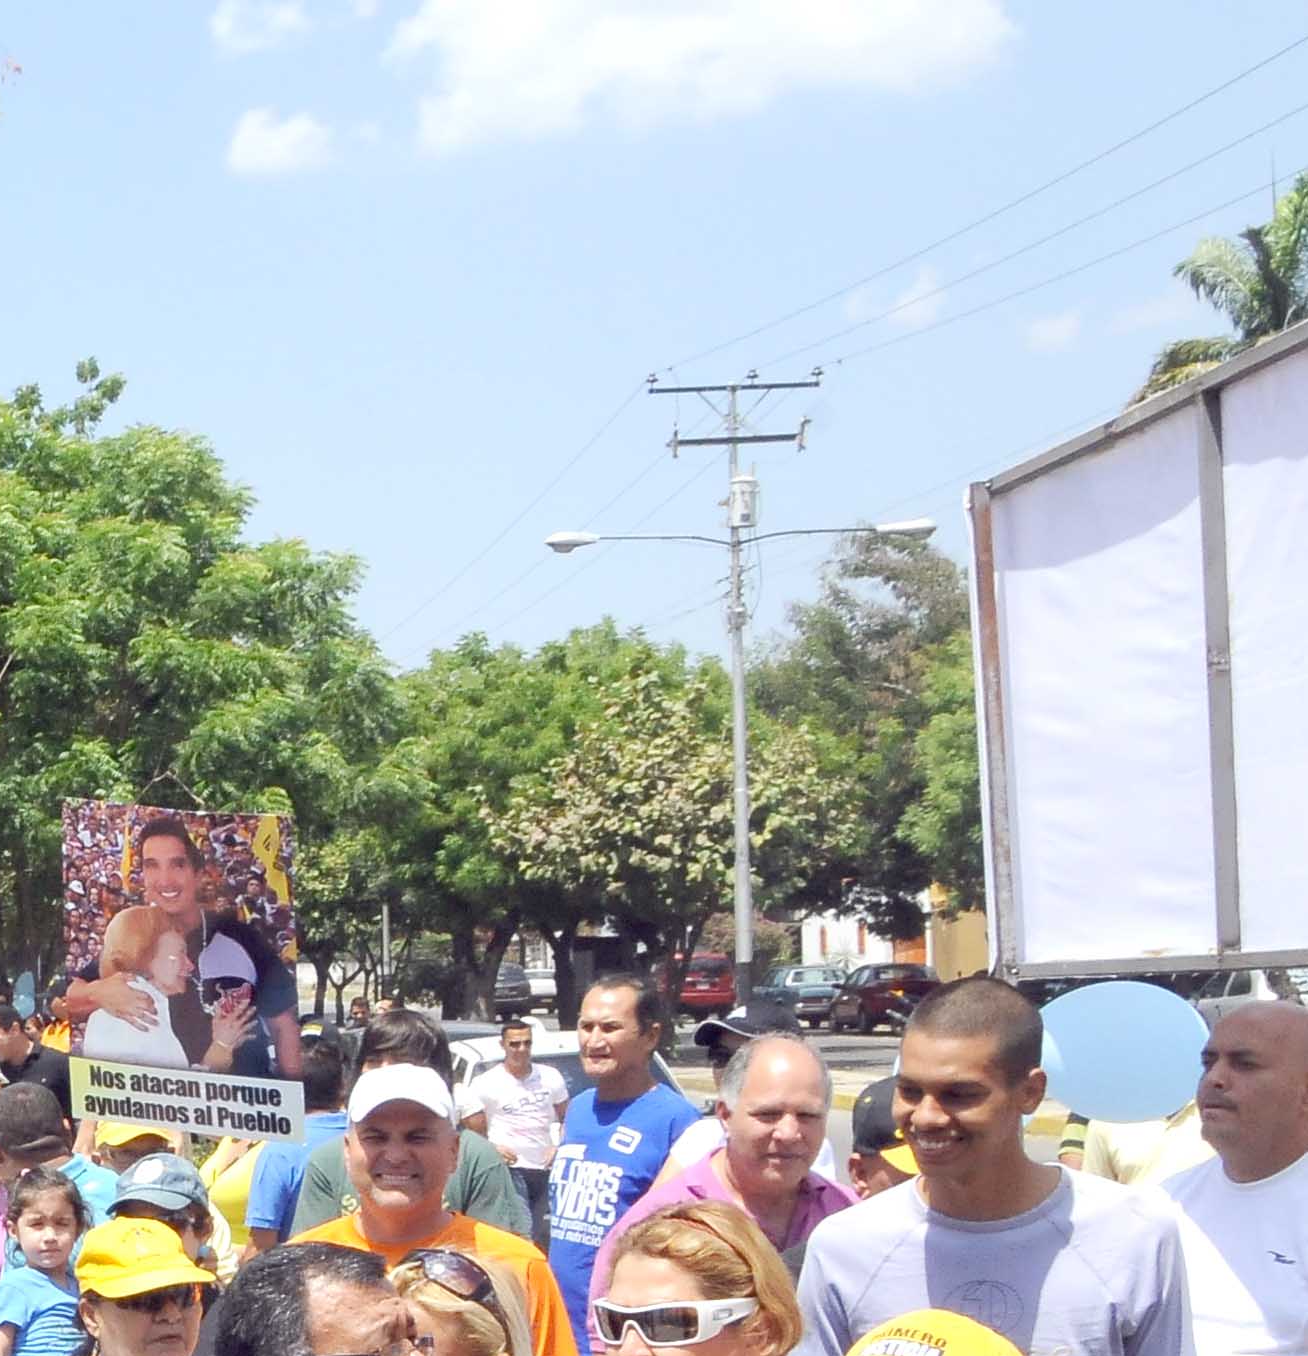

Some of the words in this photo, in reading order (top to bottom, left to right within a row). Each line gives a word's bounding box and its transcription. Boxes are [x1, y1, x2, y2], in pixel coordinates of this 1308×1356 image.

[89, 1065, 126, 1091] Nos
[130, 1072, 201, 1098] atacan
[205, 1081, 282, 1108] porque
[85, 1093, 190, 1125] ayudamos
[194, 1104, 212, 1127] al
[217, 1106, 292, 1136] Pueblo
[872, 1327, 948, 1348] IMERO
